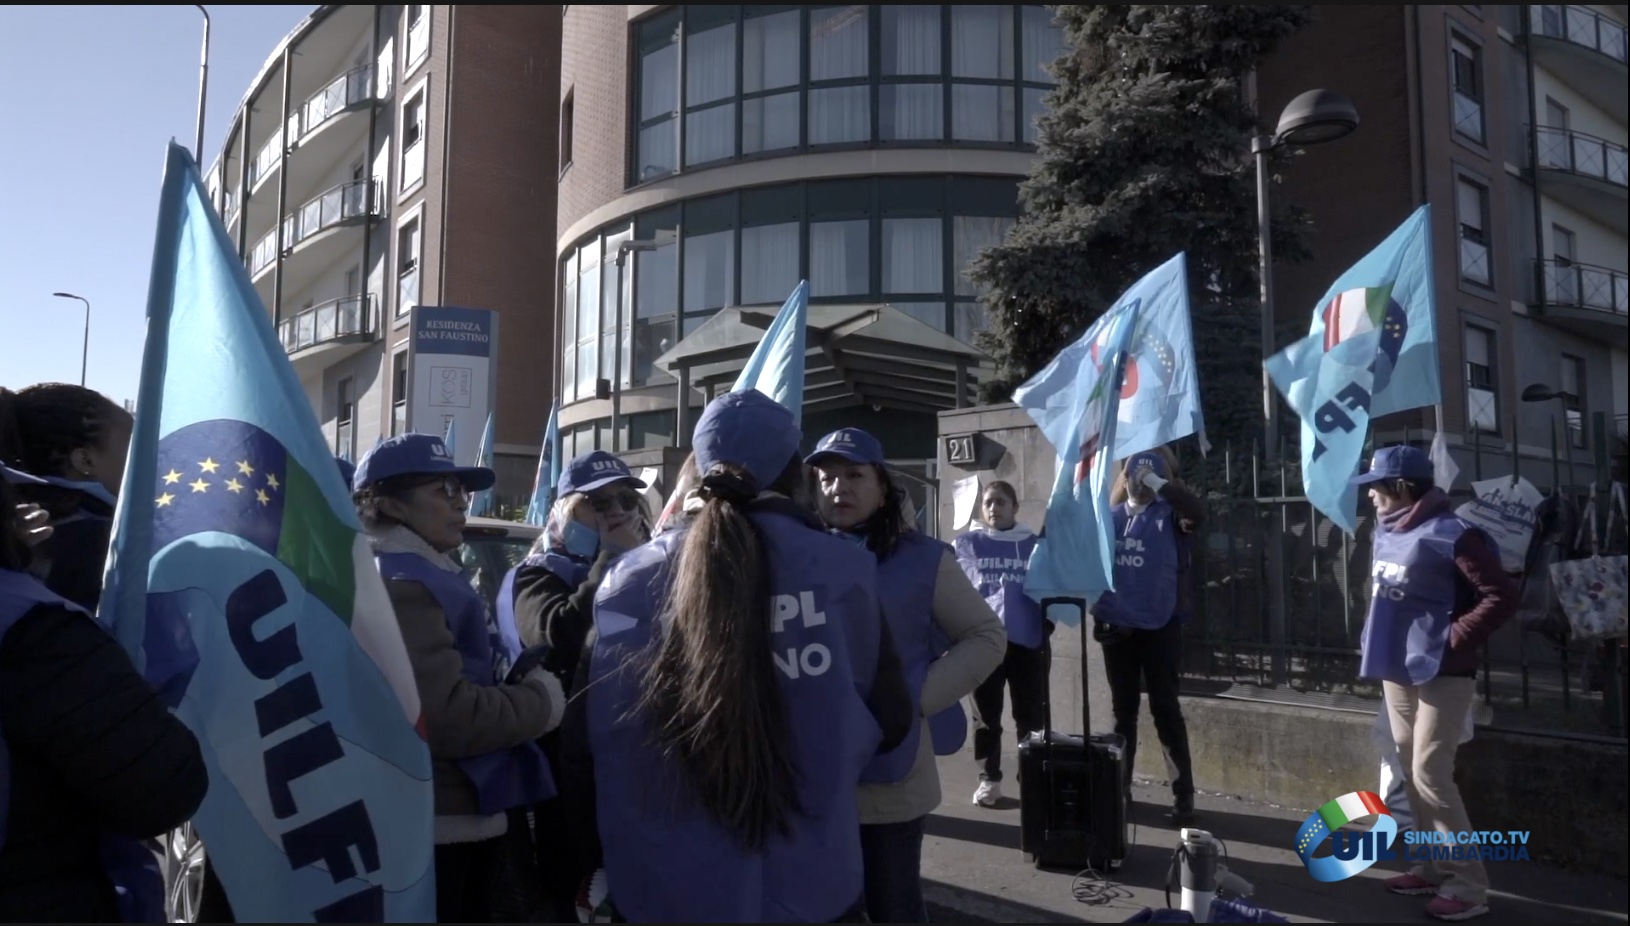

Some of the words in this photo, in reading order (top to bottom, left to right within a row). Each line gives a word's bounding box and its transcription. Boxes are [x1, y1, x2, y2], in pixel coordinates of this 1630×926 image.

[426, 320, 481, 331] RESIDENZA
[418, 331, 438, 339] SAN
[440, 332, 488, 343] FAUSTINO
[441, 369, 457, 404] KOS
[949, 438, 971, 460] 21
[592, 460, 621, 471] UIL
[770, 591, 826, 633] PL
[773, 643, 831, 679] NO
